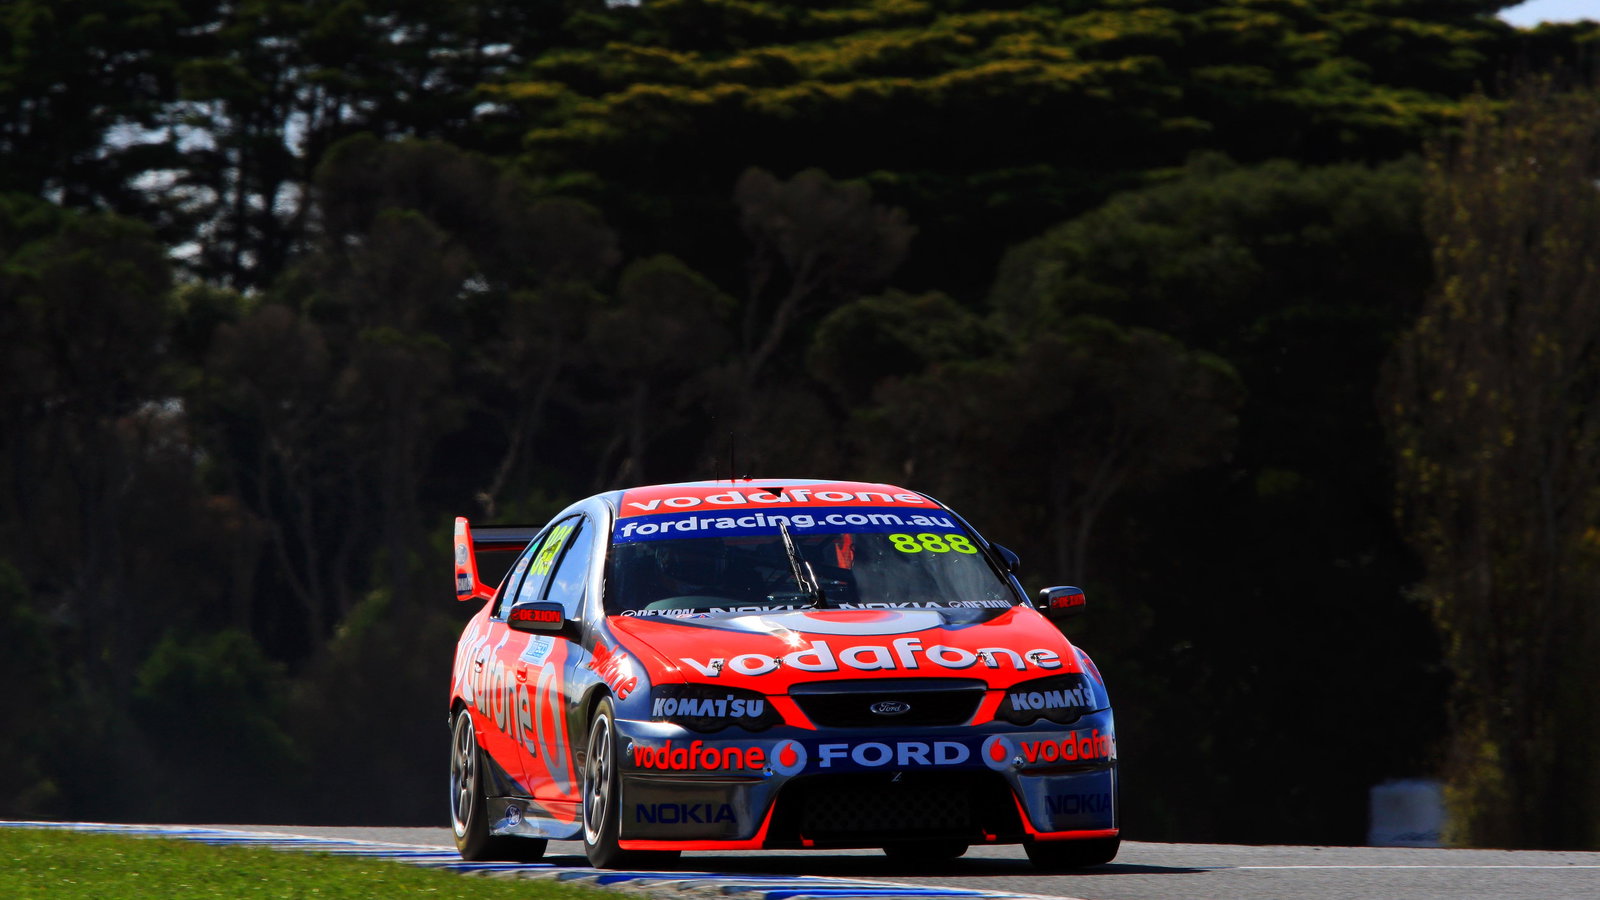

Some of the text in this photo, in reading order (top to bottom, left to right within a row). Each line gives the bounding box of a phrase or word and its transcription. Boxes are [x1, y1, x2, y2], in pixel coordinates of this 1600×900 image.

[627, 489, 925, 511] vodafone
[621, 513, 955, 537] fordracing.com.au
[889, 533, 978, 555] 888
[679, 638, 1062, 677] vodafone
[652, 695, 764, 717] KOMATSU
[879, 702, 901, 712] Ford
[634, 740, 766, 770] vodafone
[819, 742, 970, 767] FORD
[636, 803, 736, 824] NOKIA
[1045, 793, 1110, 815] NOKIA
